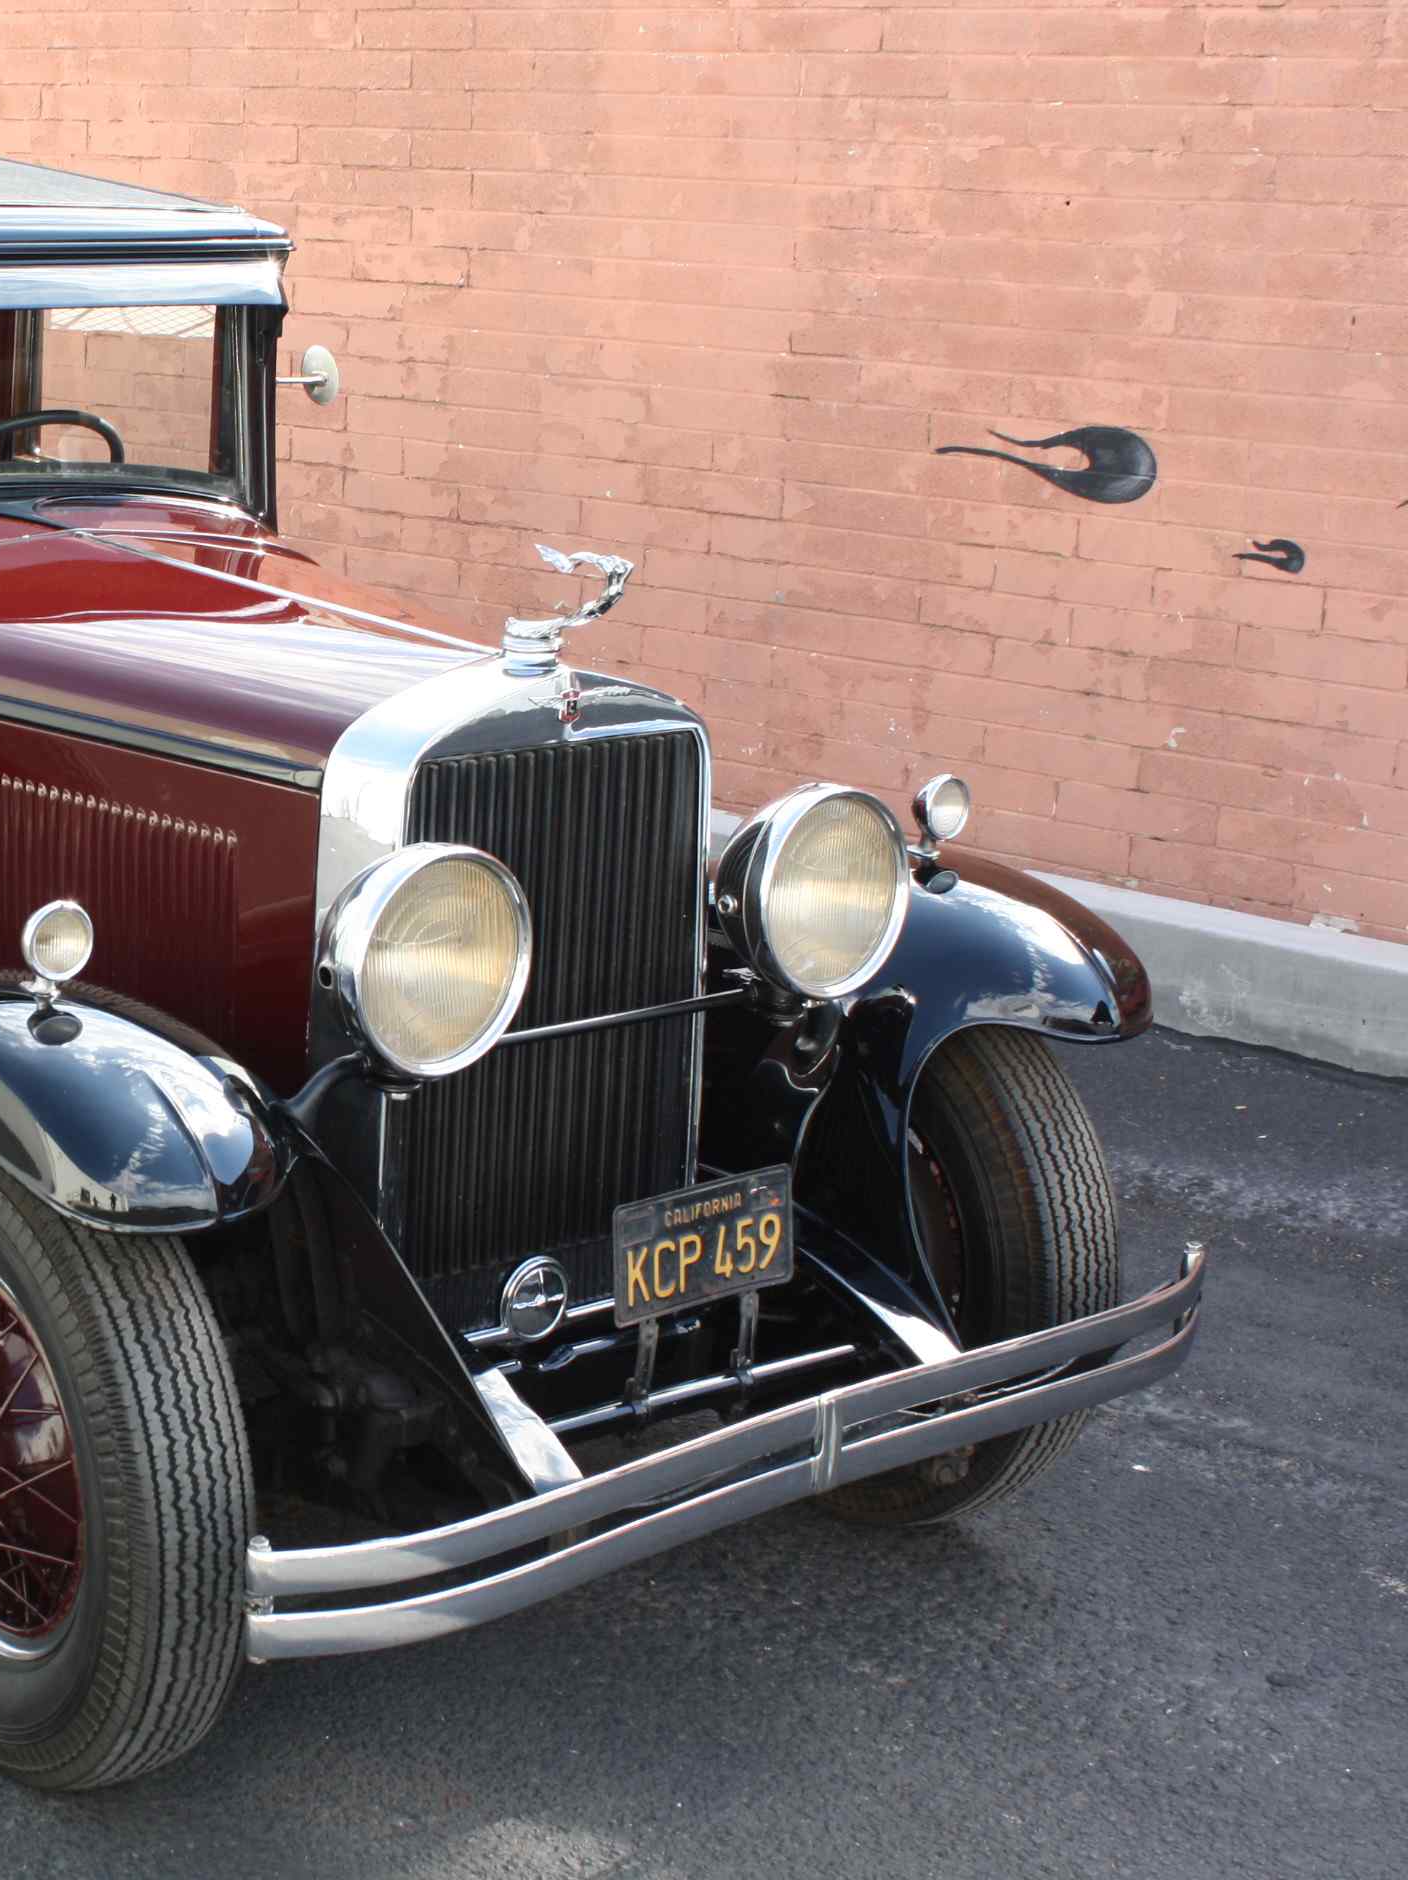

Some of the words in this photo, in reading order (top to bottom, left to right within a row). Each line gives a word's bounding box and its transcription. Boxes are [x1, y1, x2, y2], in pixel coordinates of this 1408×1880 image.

[664, 1192, 742, 1227] CALIFORNIA
[627, 1234, 702, 1308] KCP
[714, 1213, 782, 1279] 459
